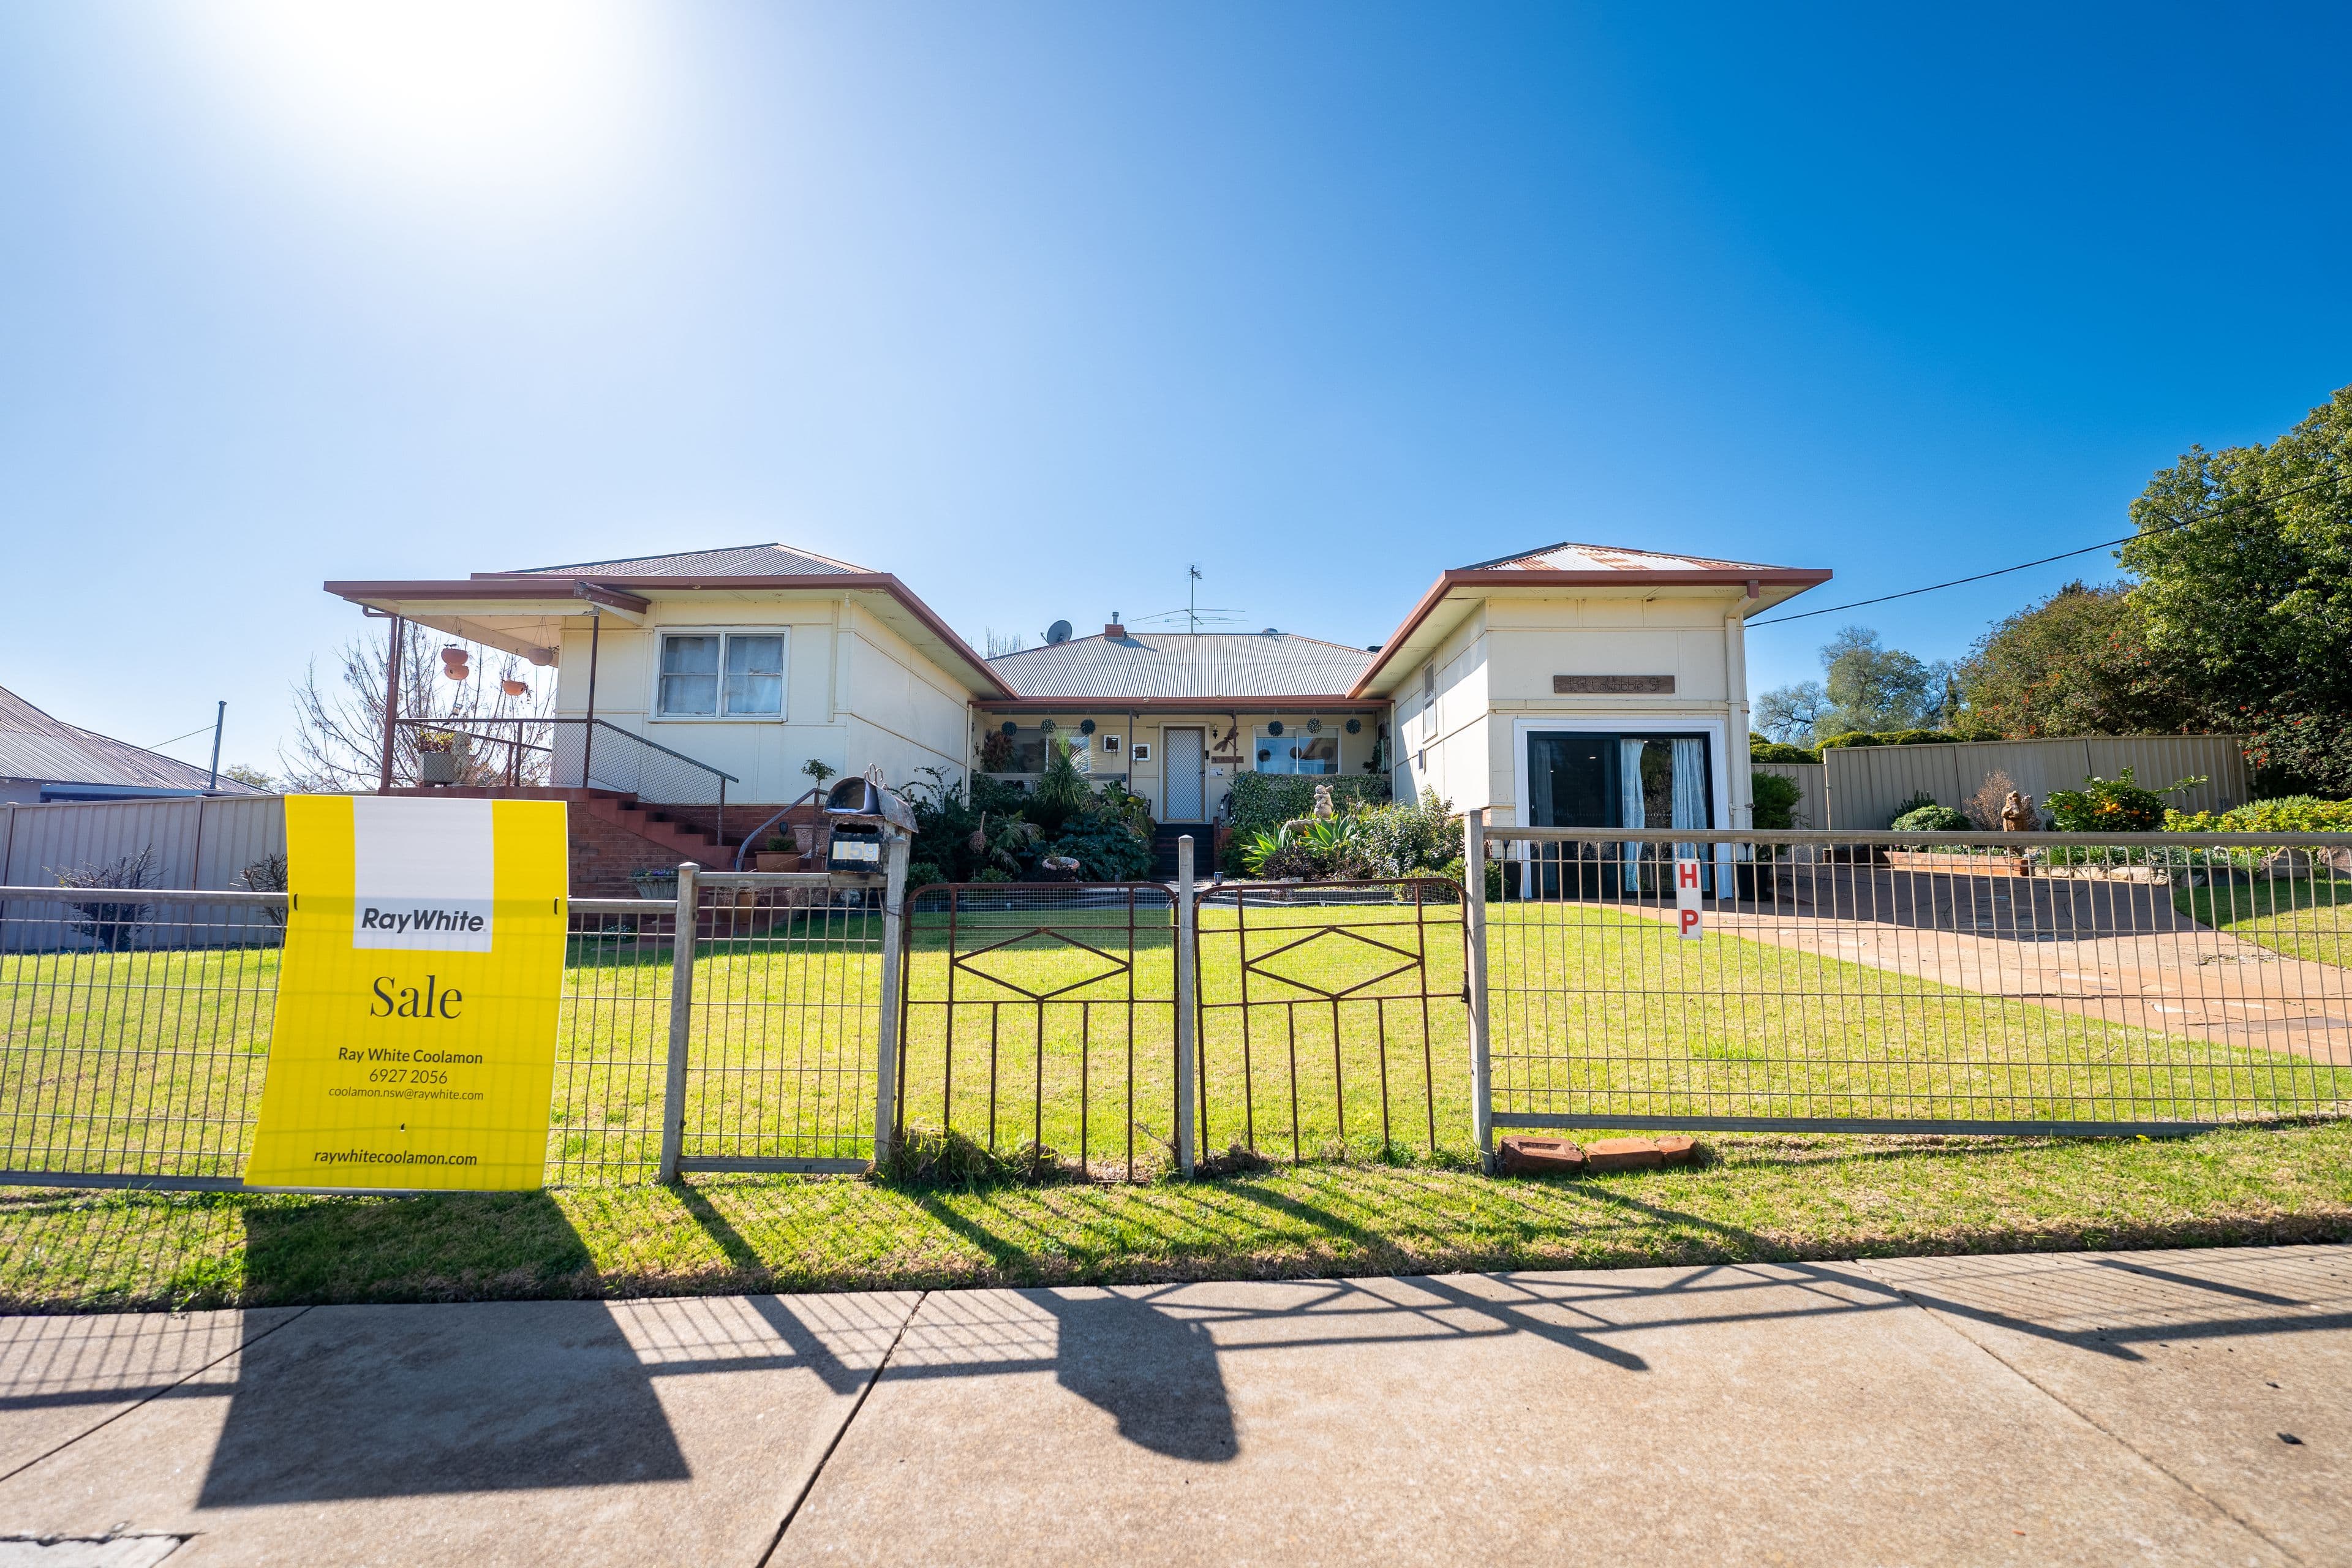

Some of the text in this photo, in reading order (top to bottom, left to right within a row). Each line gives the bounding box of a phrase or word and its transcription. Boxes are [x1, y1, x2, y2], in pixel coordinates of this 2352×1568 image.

[1569, 677, 1587, 692] 159
[1649, 677, 1661, 692] St
[836, 842, 876, 861] 159
[370, 975, 463, 1019] Sale
[339, 1047, 483, 1065] Ray White Coolamon
[369, 1069, 448, 1084] 6927 2056
[328, 1086, 484, 1101] coolamon.nsw@raywhite.com
[314, 1148, 478, 1166] raywhitecoolamon.com
